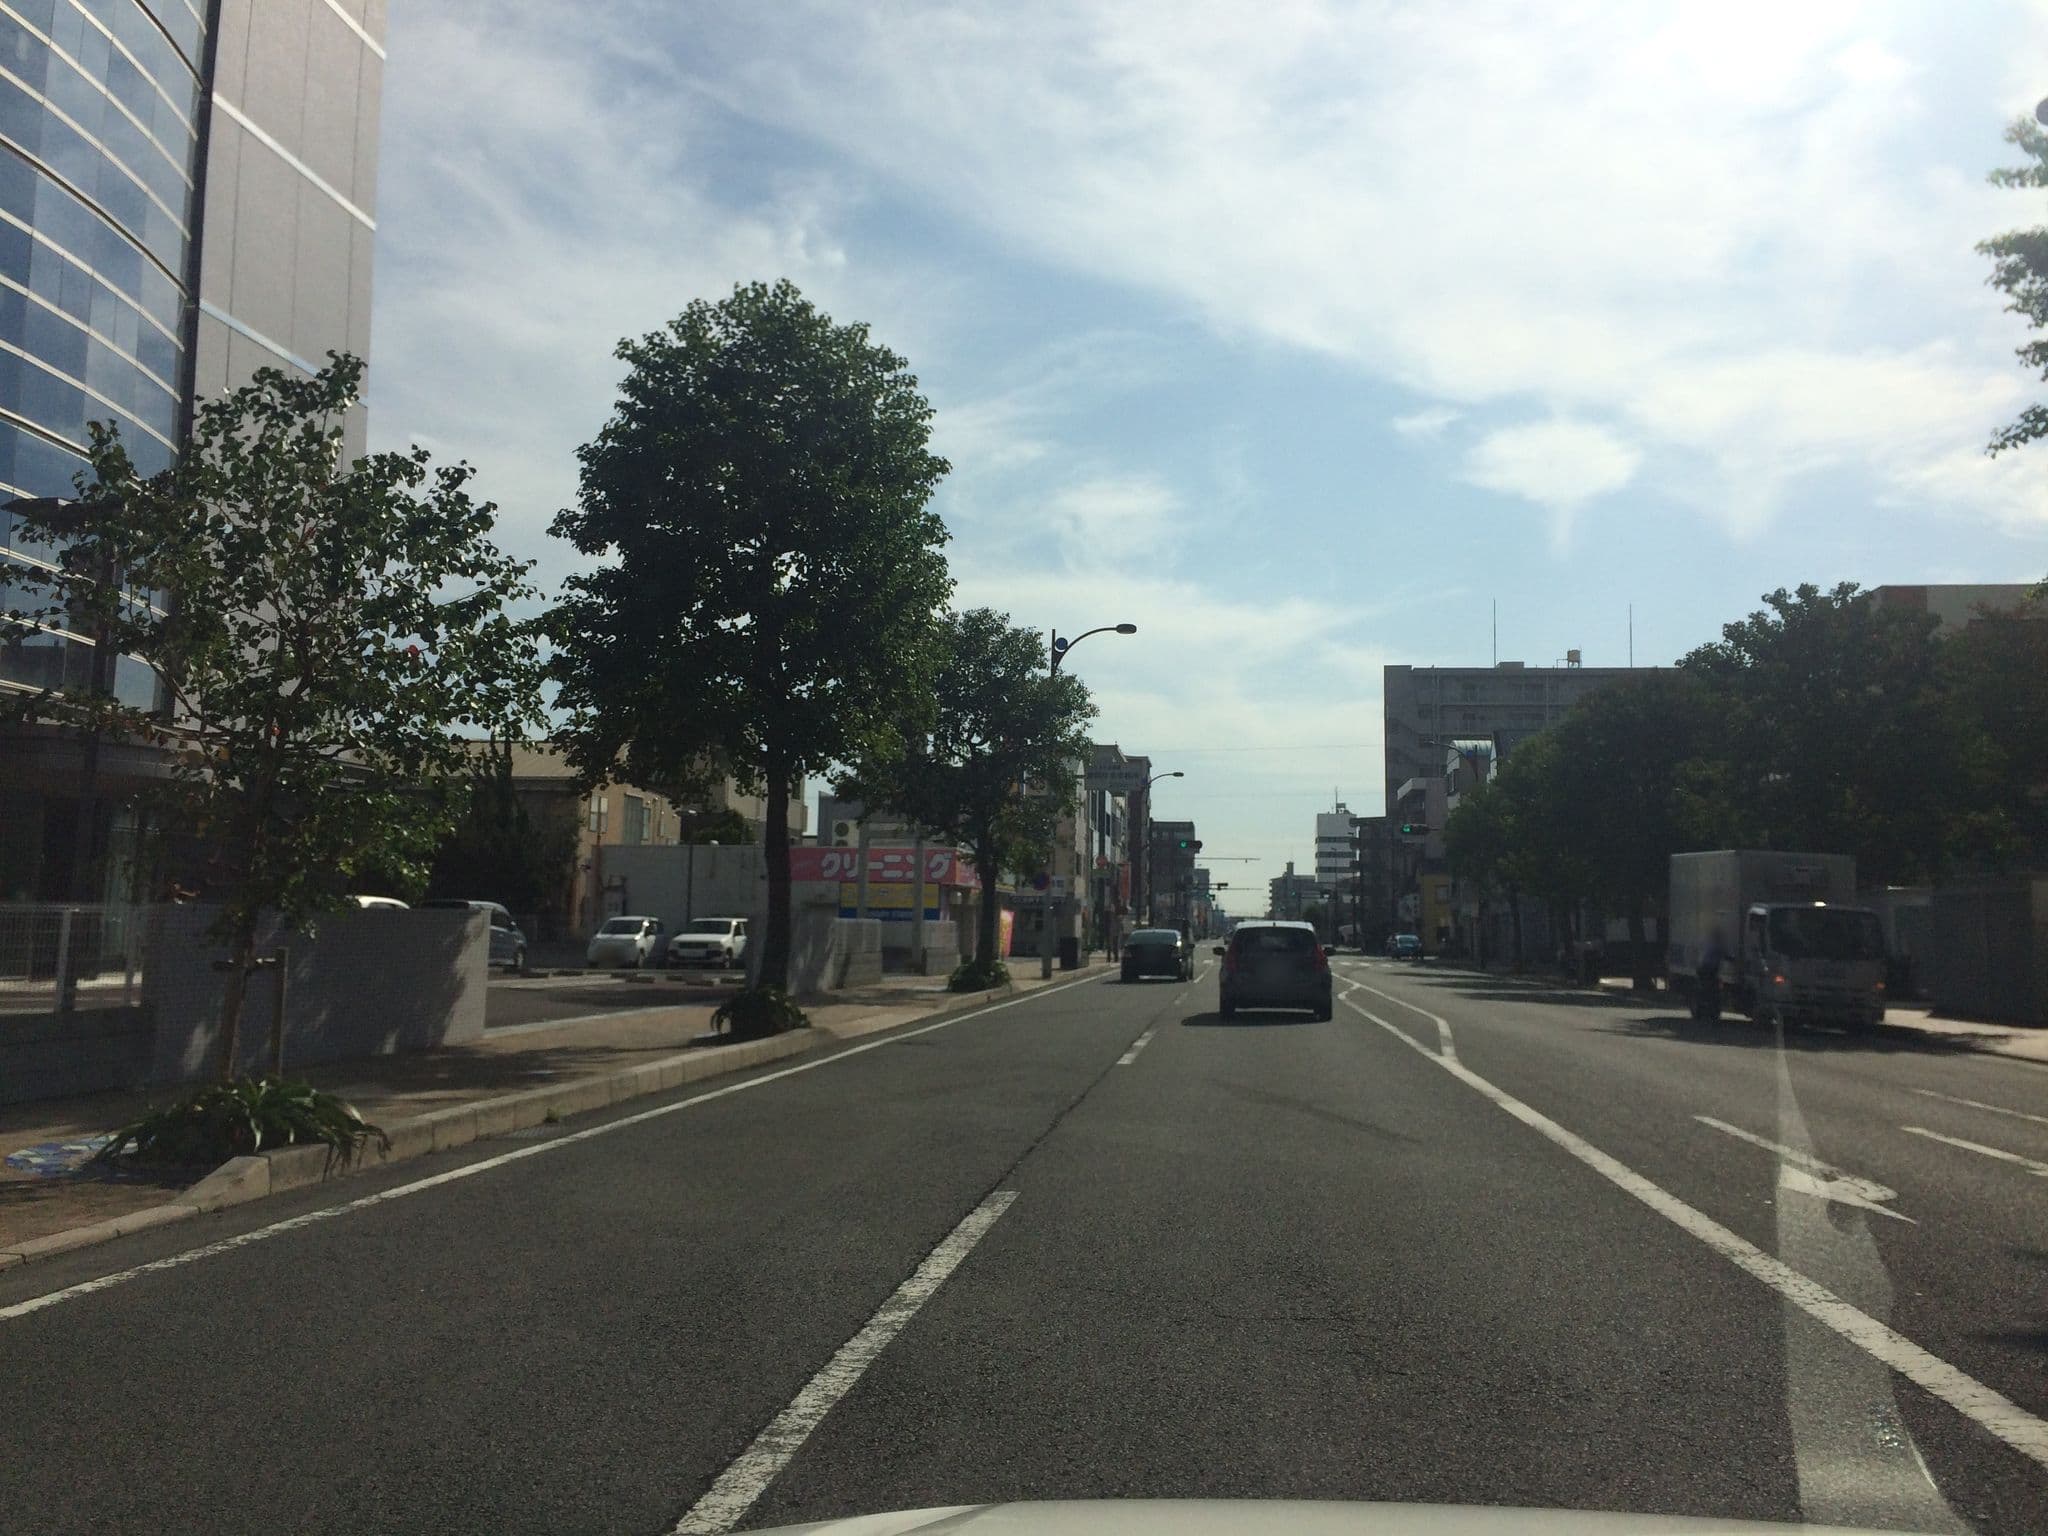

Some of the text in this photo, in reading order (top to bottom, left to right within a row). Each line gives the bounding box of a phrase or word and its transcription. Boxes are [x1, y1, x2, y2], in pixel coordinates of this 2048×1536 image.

[822, 853, 953, 879] クリーニング
